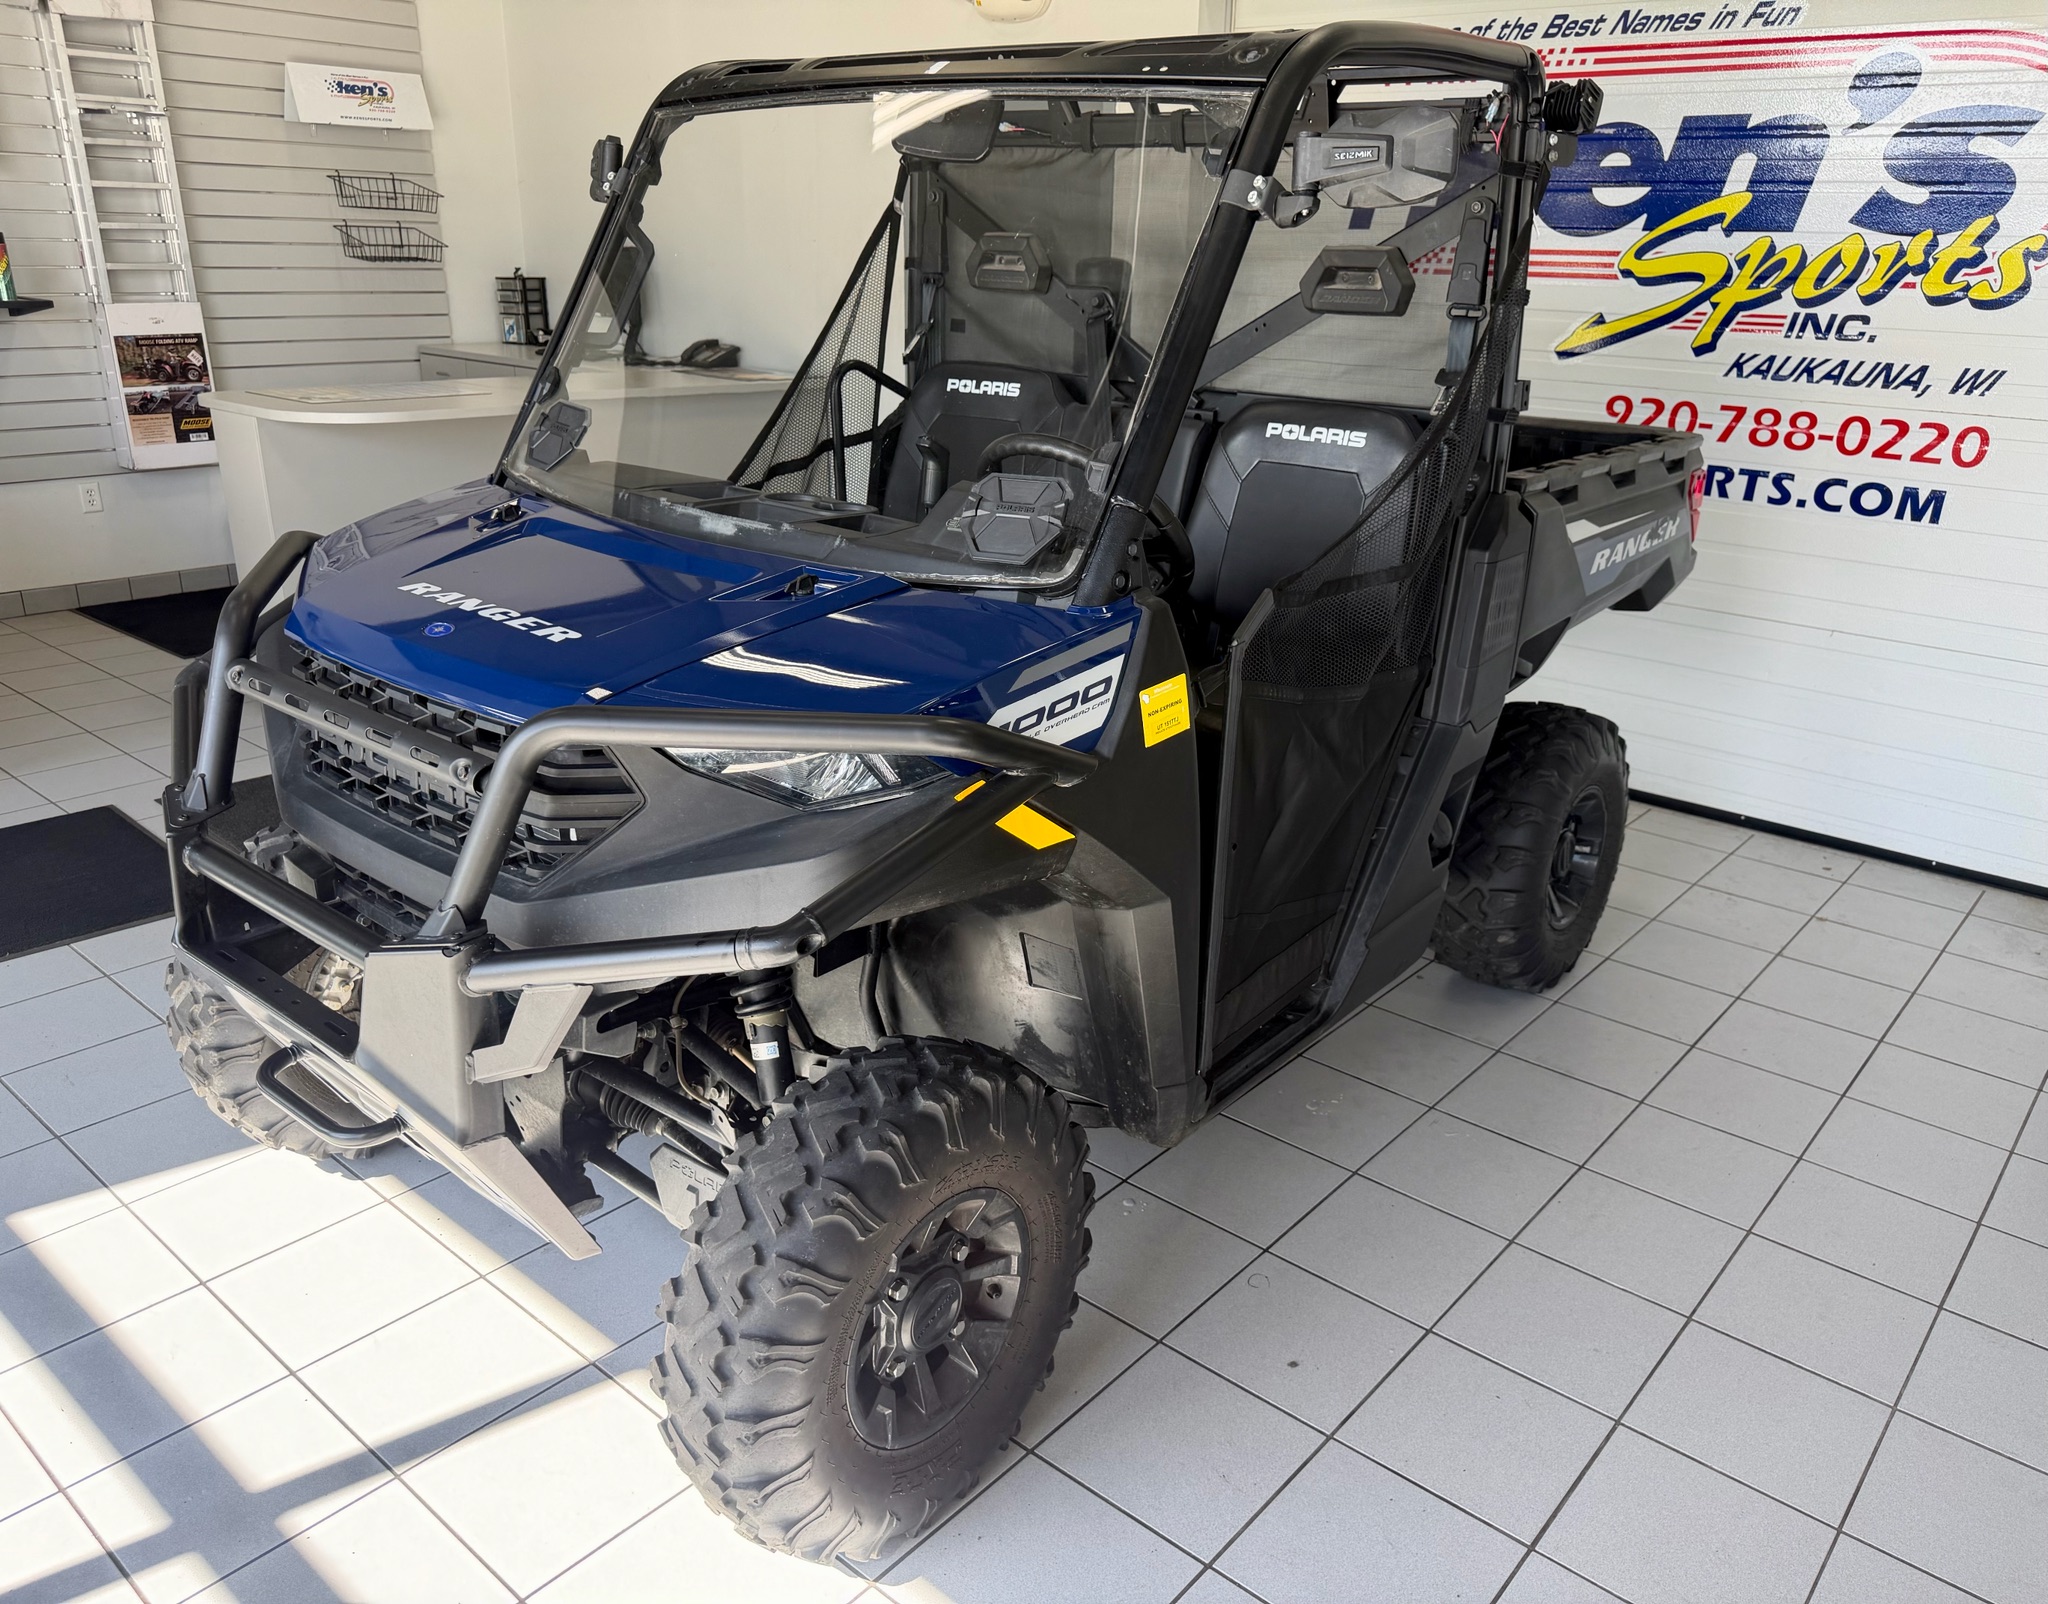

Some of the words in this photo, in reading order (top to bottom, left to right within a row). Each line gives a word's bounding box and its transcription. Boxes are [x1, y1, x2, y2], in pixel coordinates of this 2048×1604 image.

[1496, 16, 1538, 40] the
[1540, 13, 1608, 39] Best
[1609, 9, 1706, 35] Names
[1708, 4, 1740, 29] in
[1743, 1, 1803, 28] Fun
[336, 80, 388, 97] ken's
[1334, 150, 1373, 160] SEIZMIK
[1534, 50, 2046, 238] en's
[1555, 192, 2048, 359] Sports
[1783, 312, 1876, 343] INC.
[946, 378, 1021, 397] POLARIS
[1722, 353, 1932, 398] KAUKAUNA,
[1949, 368, 2007, 397] WI
[183, 418, 210, 426] MOOSE
[1265, 422, 1367, 448] POLARIS
[1605, 395, 1991, 469] 920-788-0220
[397, 581, 583, 643] RANGER
[1044, 707, 1090, 732] OVERHEAD
[1091, 697, 1111, 710] CAM
